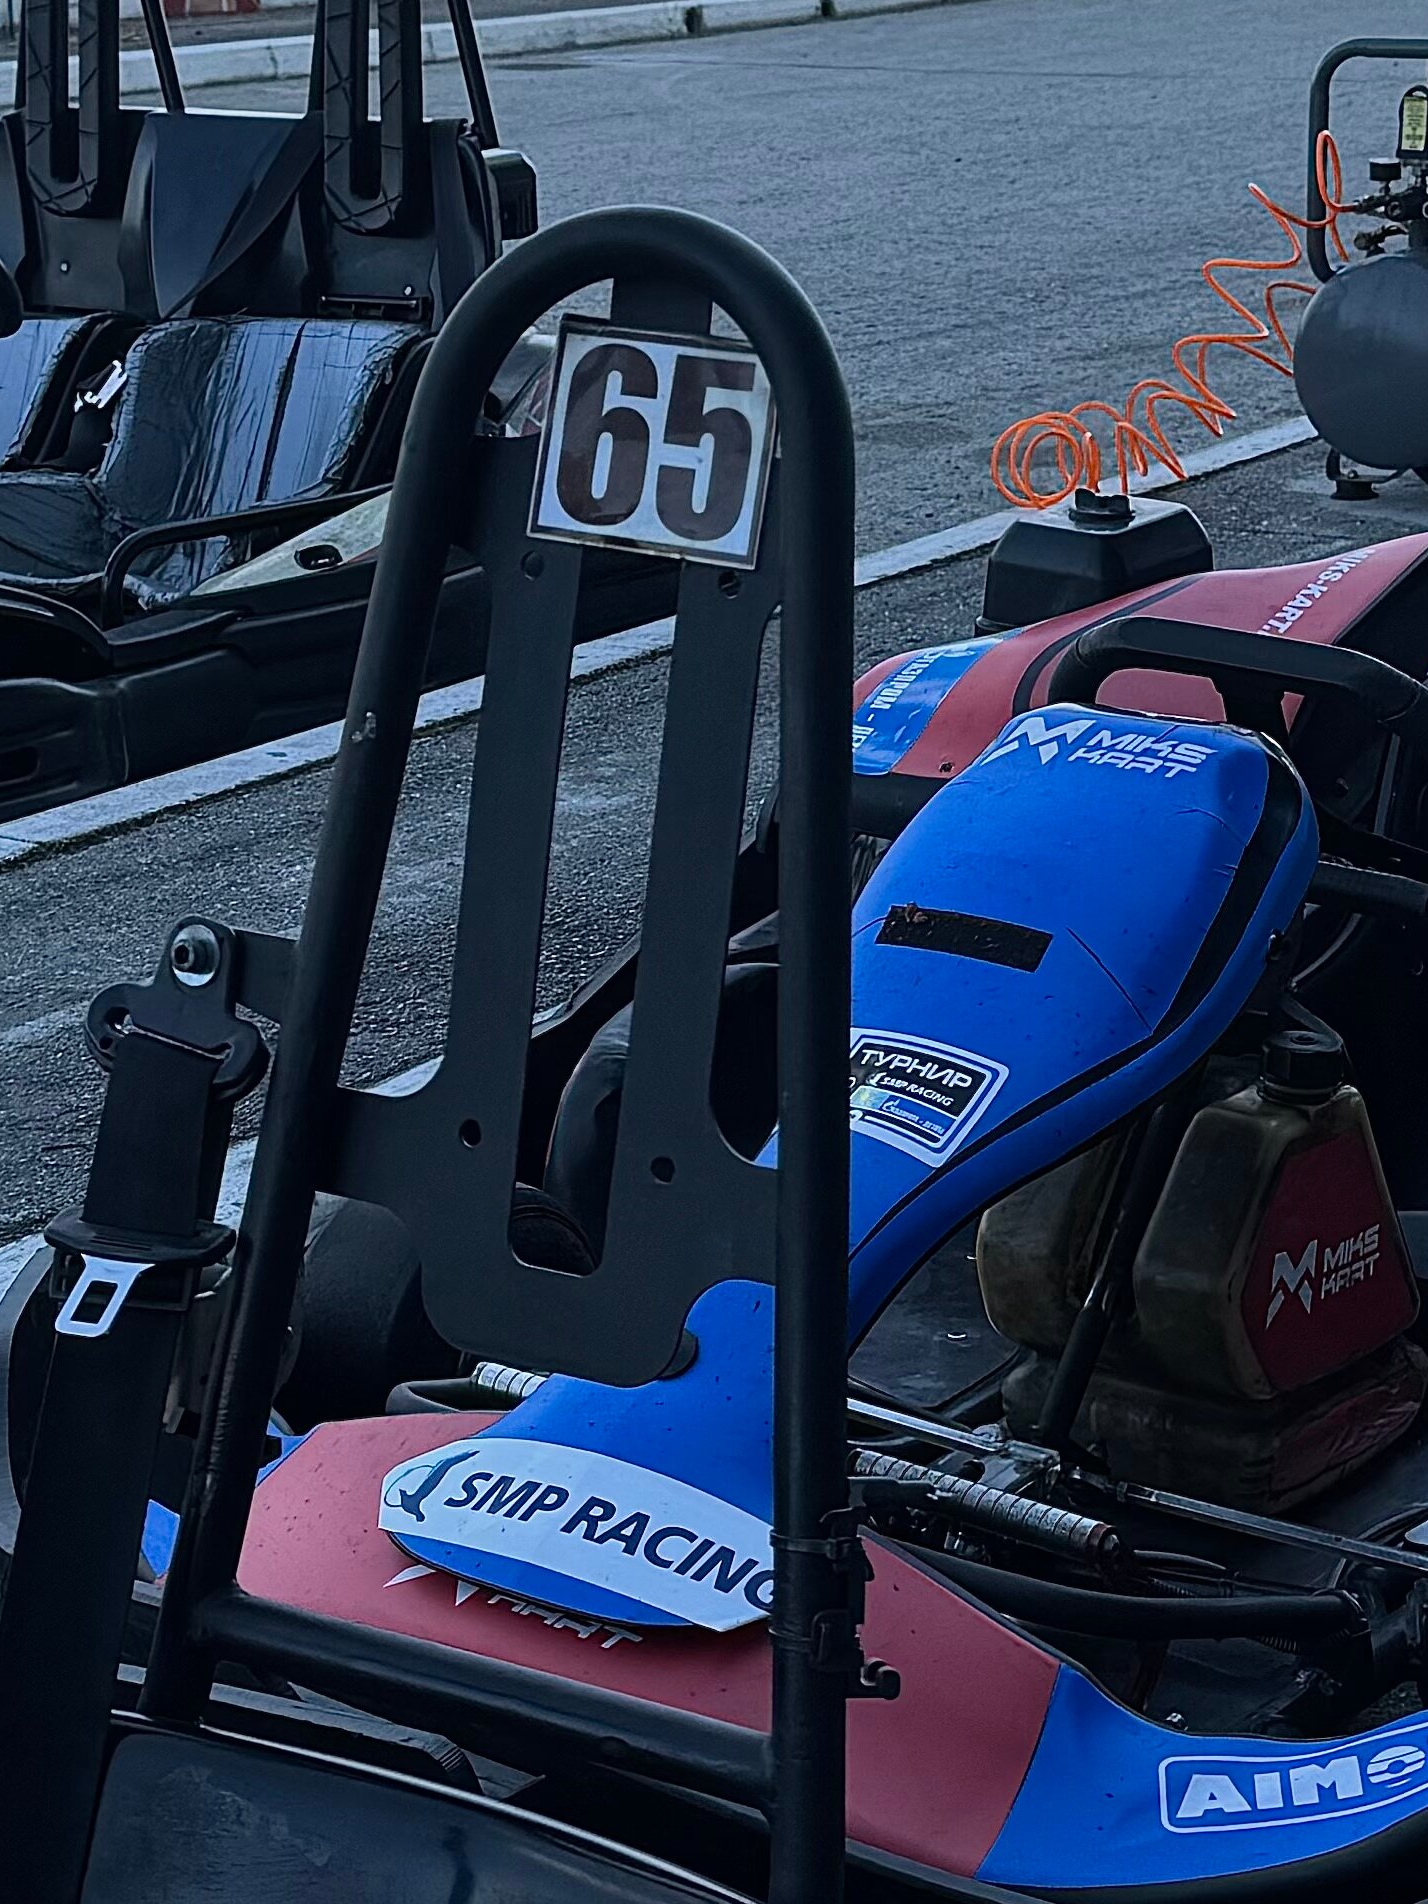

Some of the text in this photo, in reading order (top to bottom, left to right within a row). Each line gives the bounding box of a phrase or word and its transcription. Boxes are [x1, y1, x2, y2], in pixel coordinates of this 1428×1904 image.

[556, 343, 757, 542] 65
[1067, 747, 1197, 778] KART
[1086, 730, 1219, 764] MIKS
[861, 1049, 973, 1088] ТУРНИР
[906, 1083, 954, 1107] RACING
[1323, 1223, 1380, 1273] MIKS
[1321, 1252, 1380, 1300] KART
[444, 1472, 570, 1522] SMP
